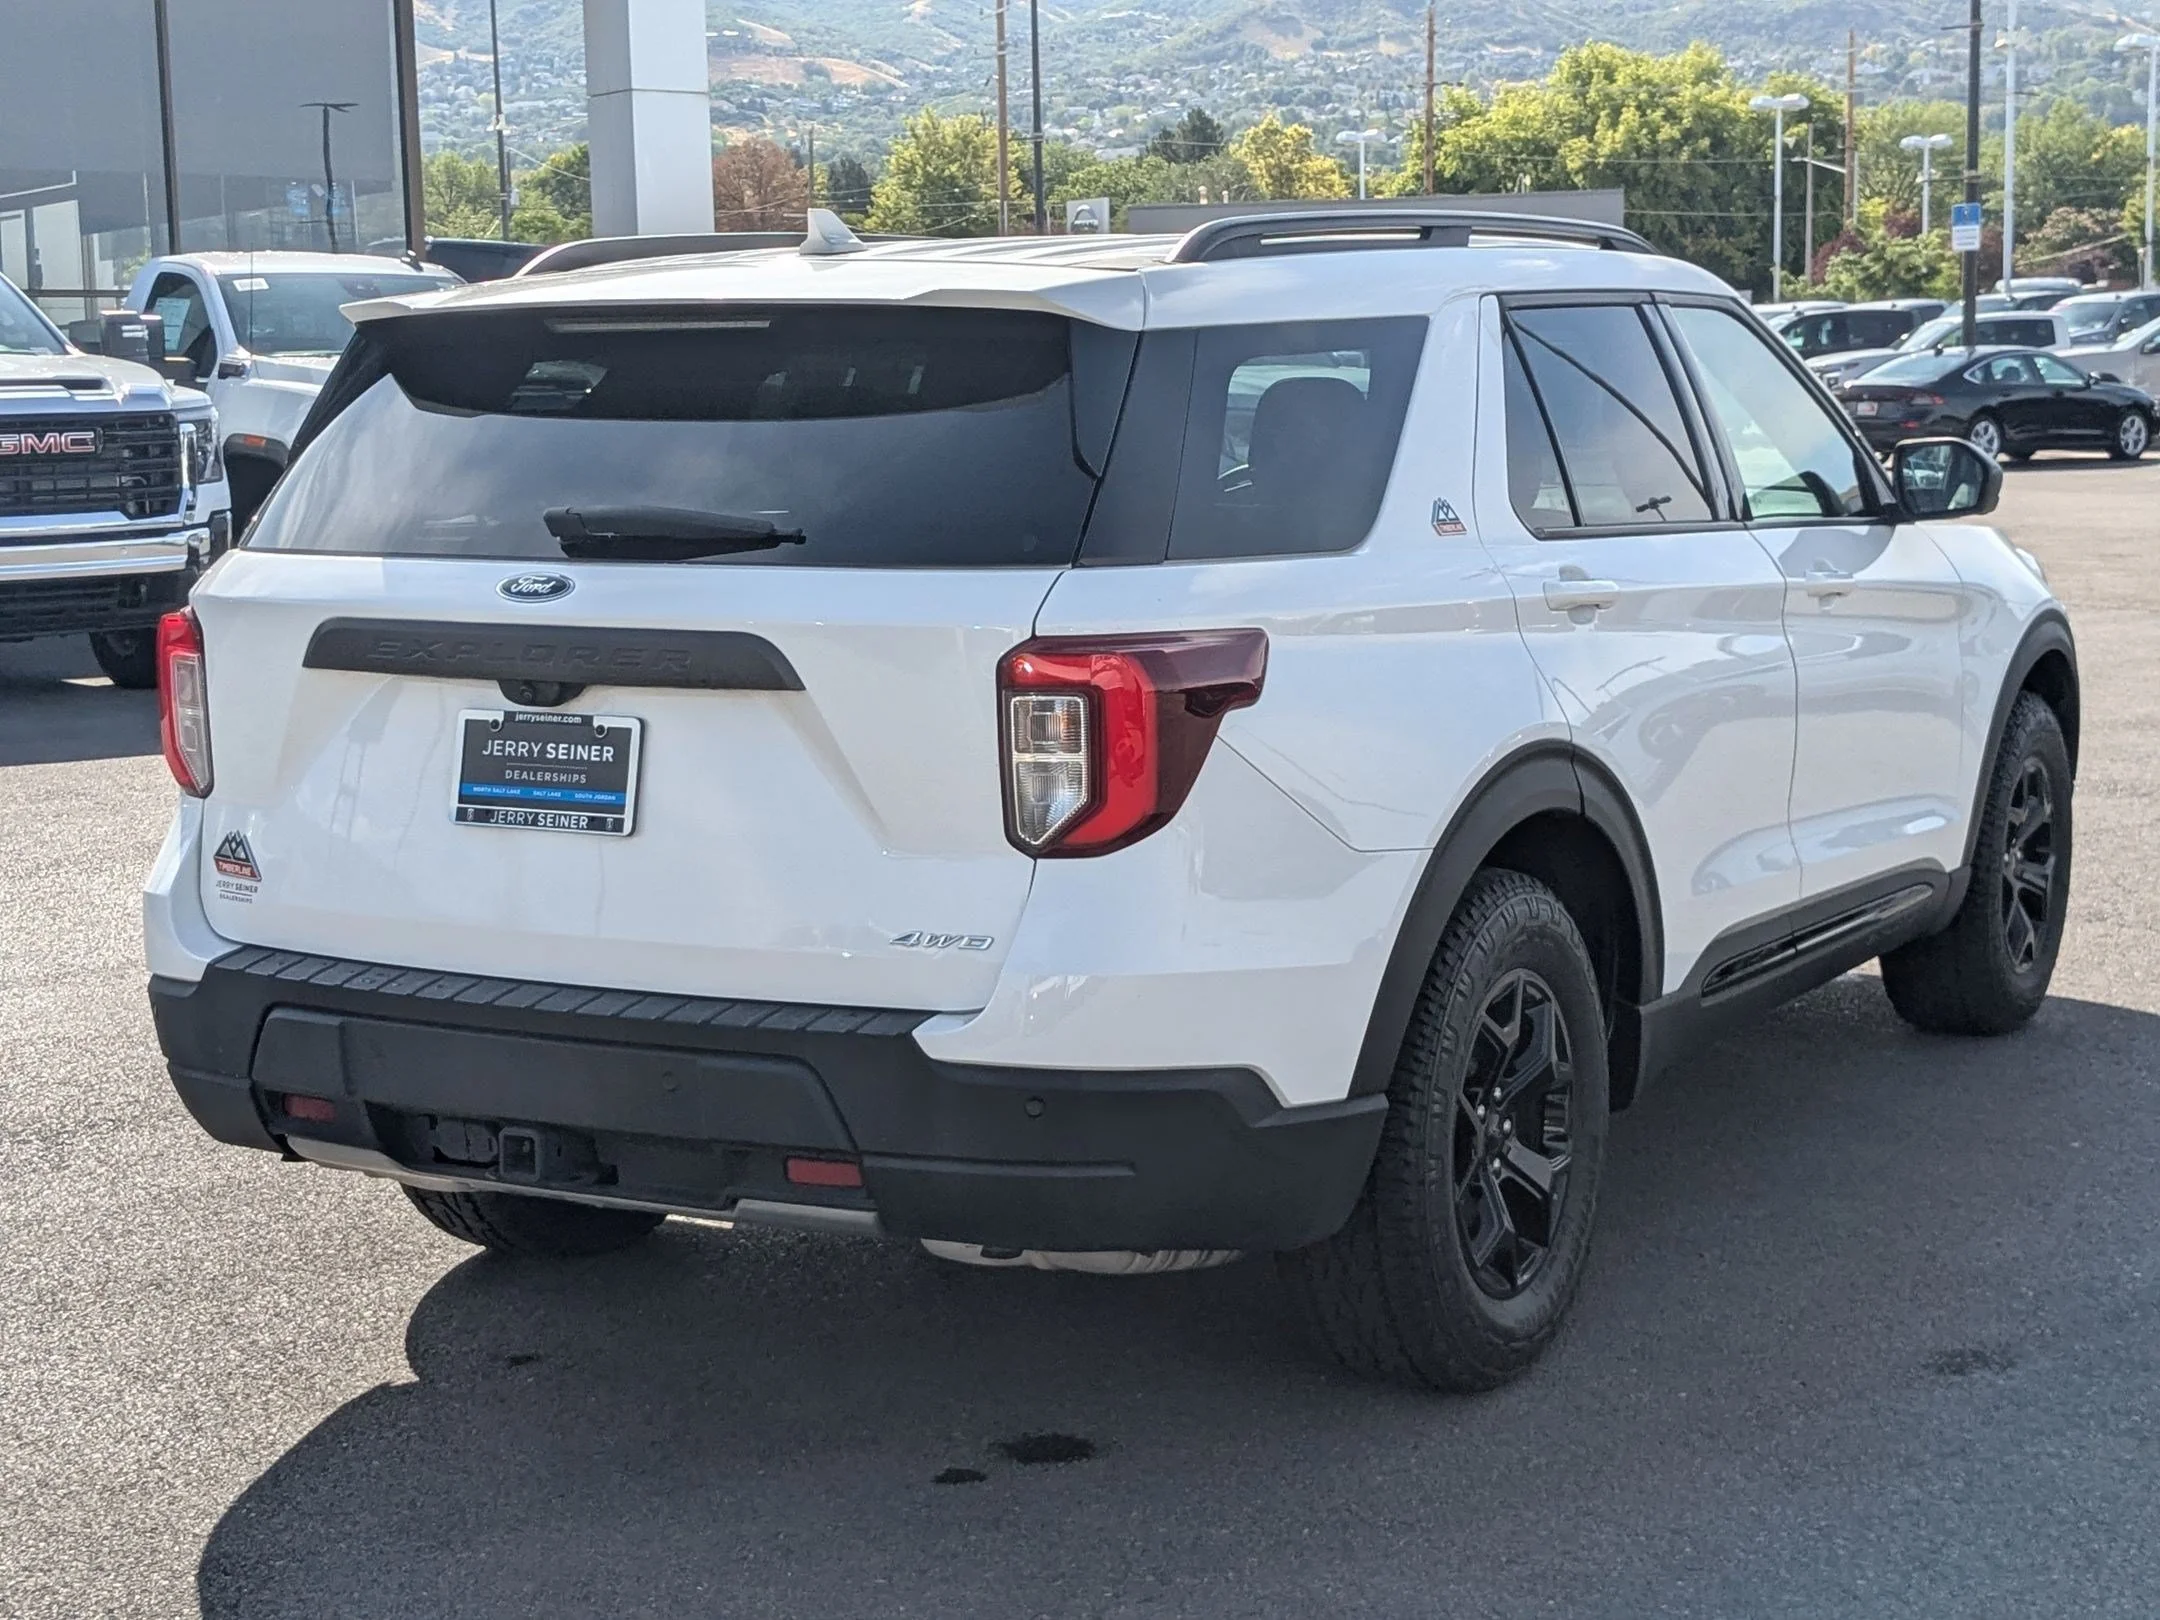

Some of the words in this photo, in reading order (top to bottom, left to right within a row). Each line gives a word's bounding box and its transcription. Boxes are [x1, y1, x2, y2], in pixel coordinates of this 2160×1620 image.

[0, 431, 95, 455] GMC
[511, 576, 556, 593] Ford
[366, 640, 692, 671] EXPLORER
[515, 712, 582, 724] jerryseiner.com
[482, 740, 543, 758] JERRY
[546, 743, 614, 762] SEINER
[505, 770, 587, 784] DEALERSHIPS
[490, 810, 535, 825] JERRY
[537, 813, 588, 829] SEINER
[215, 880, 234, 890] JERRY
[235, 882, 258, 893] SEINER
[889, 931, 995, 951] 4WD
